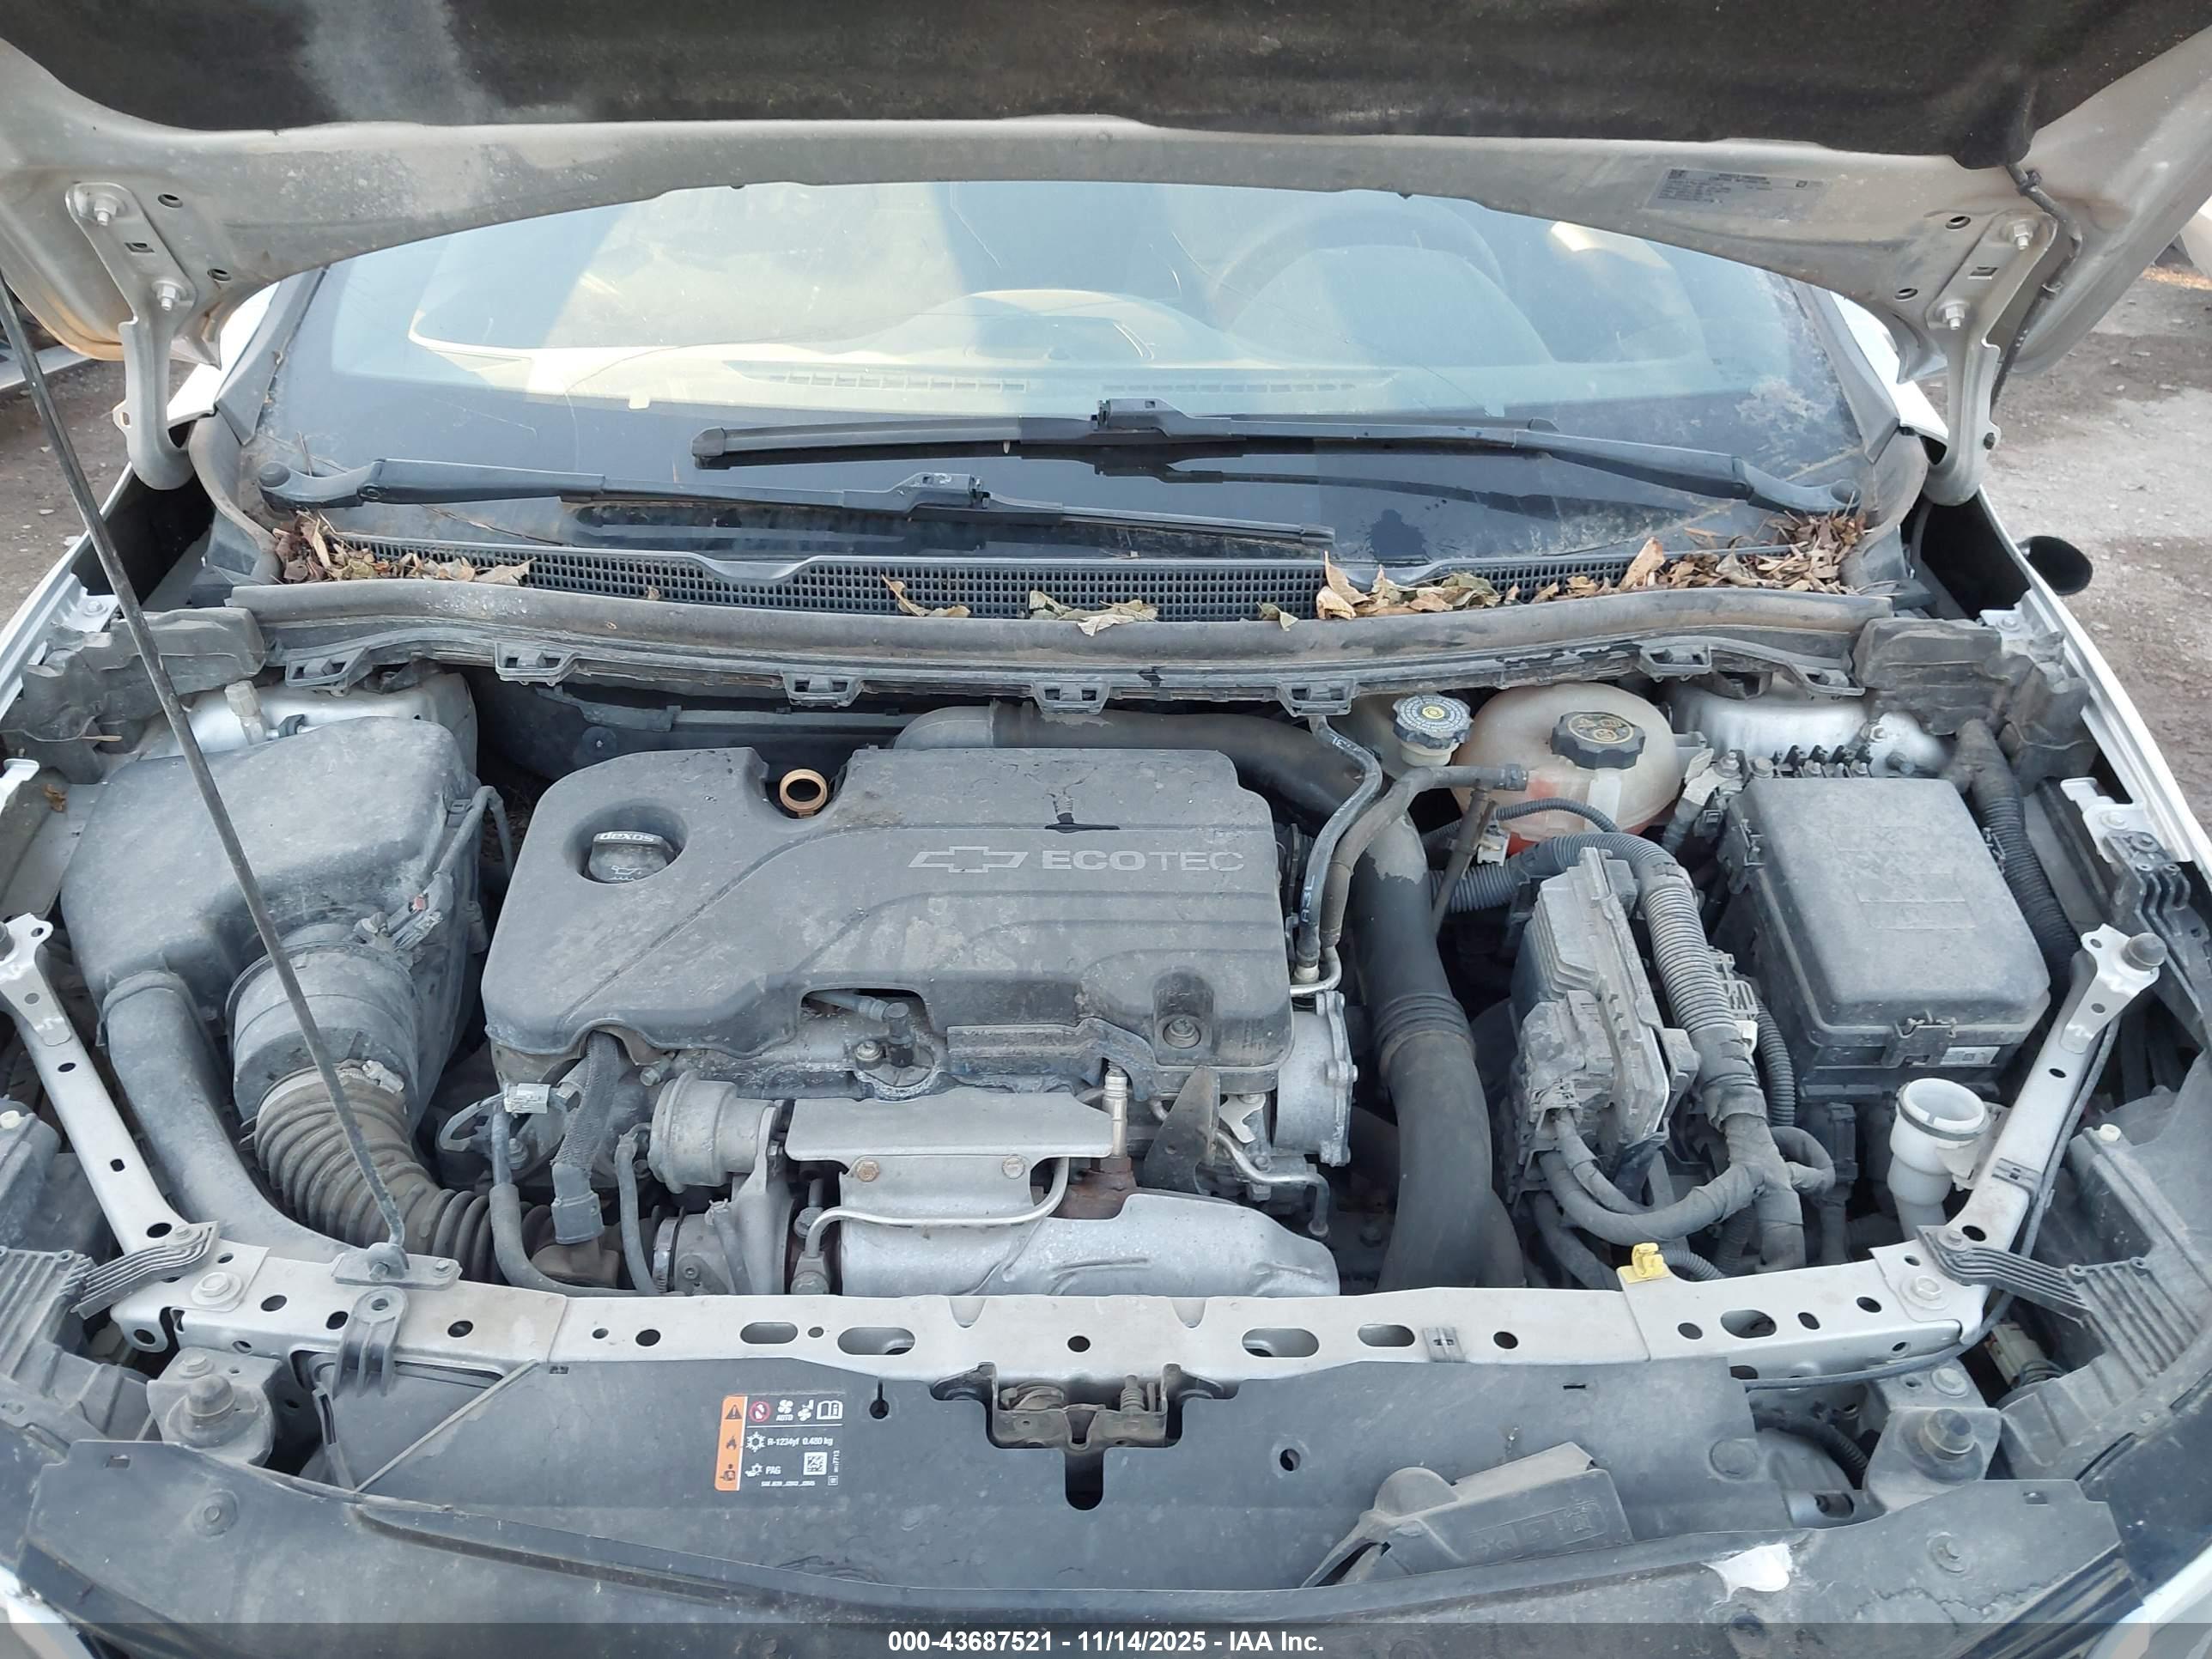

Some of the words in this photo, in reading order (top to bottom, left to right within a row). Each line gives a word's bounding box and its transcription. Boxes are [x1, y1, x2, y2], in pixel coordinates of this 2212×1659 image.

[599, 831, 653, 842] dexos
[1042, 849, 1245, 872] ECOTEC
[823, 1437, 834, 1446] kg
[765, 1466, 781, 1474] PAG
